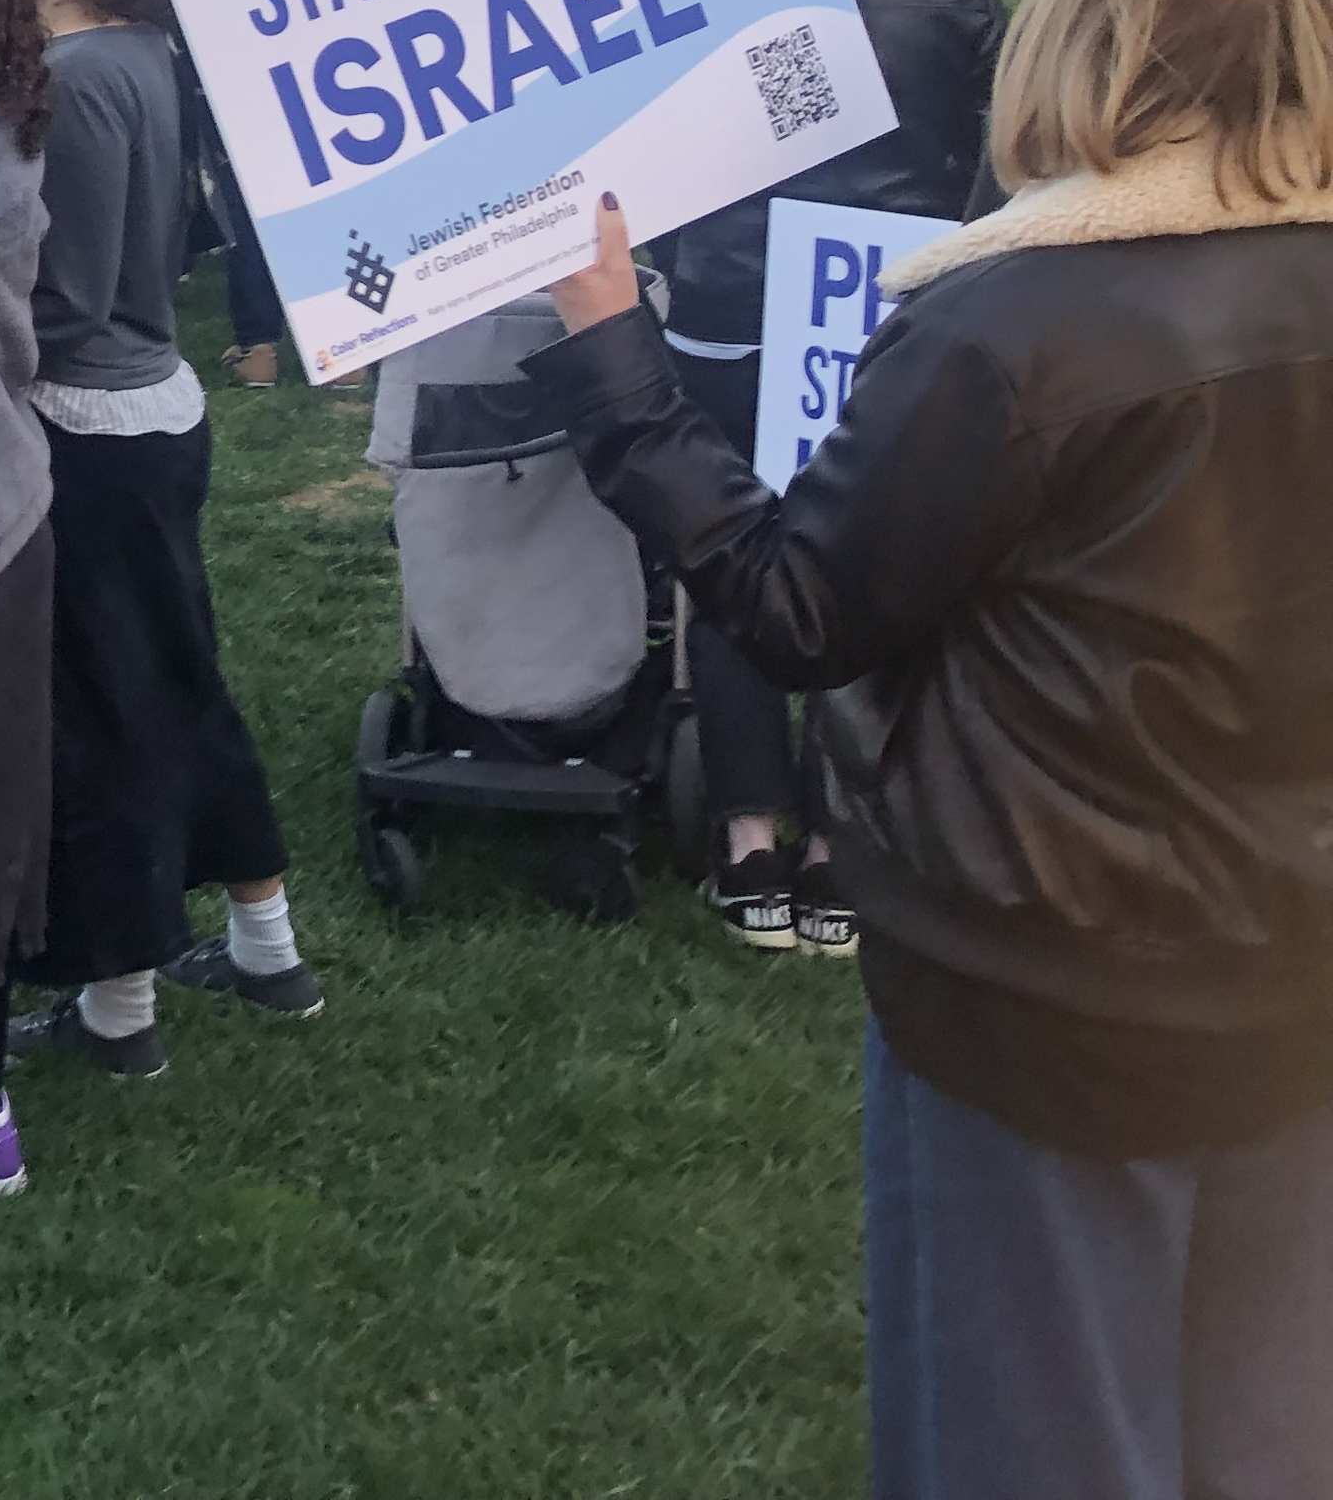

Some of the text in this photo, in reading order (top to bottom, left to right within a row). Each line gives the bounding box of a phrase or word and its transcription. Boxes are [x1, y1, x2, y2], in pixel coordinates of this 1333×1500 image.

[407, 169, 585, 256] Jewish Federation
[415, 200, 579, 281] of Greater Philadelphia
